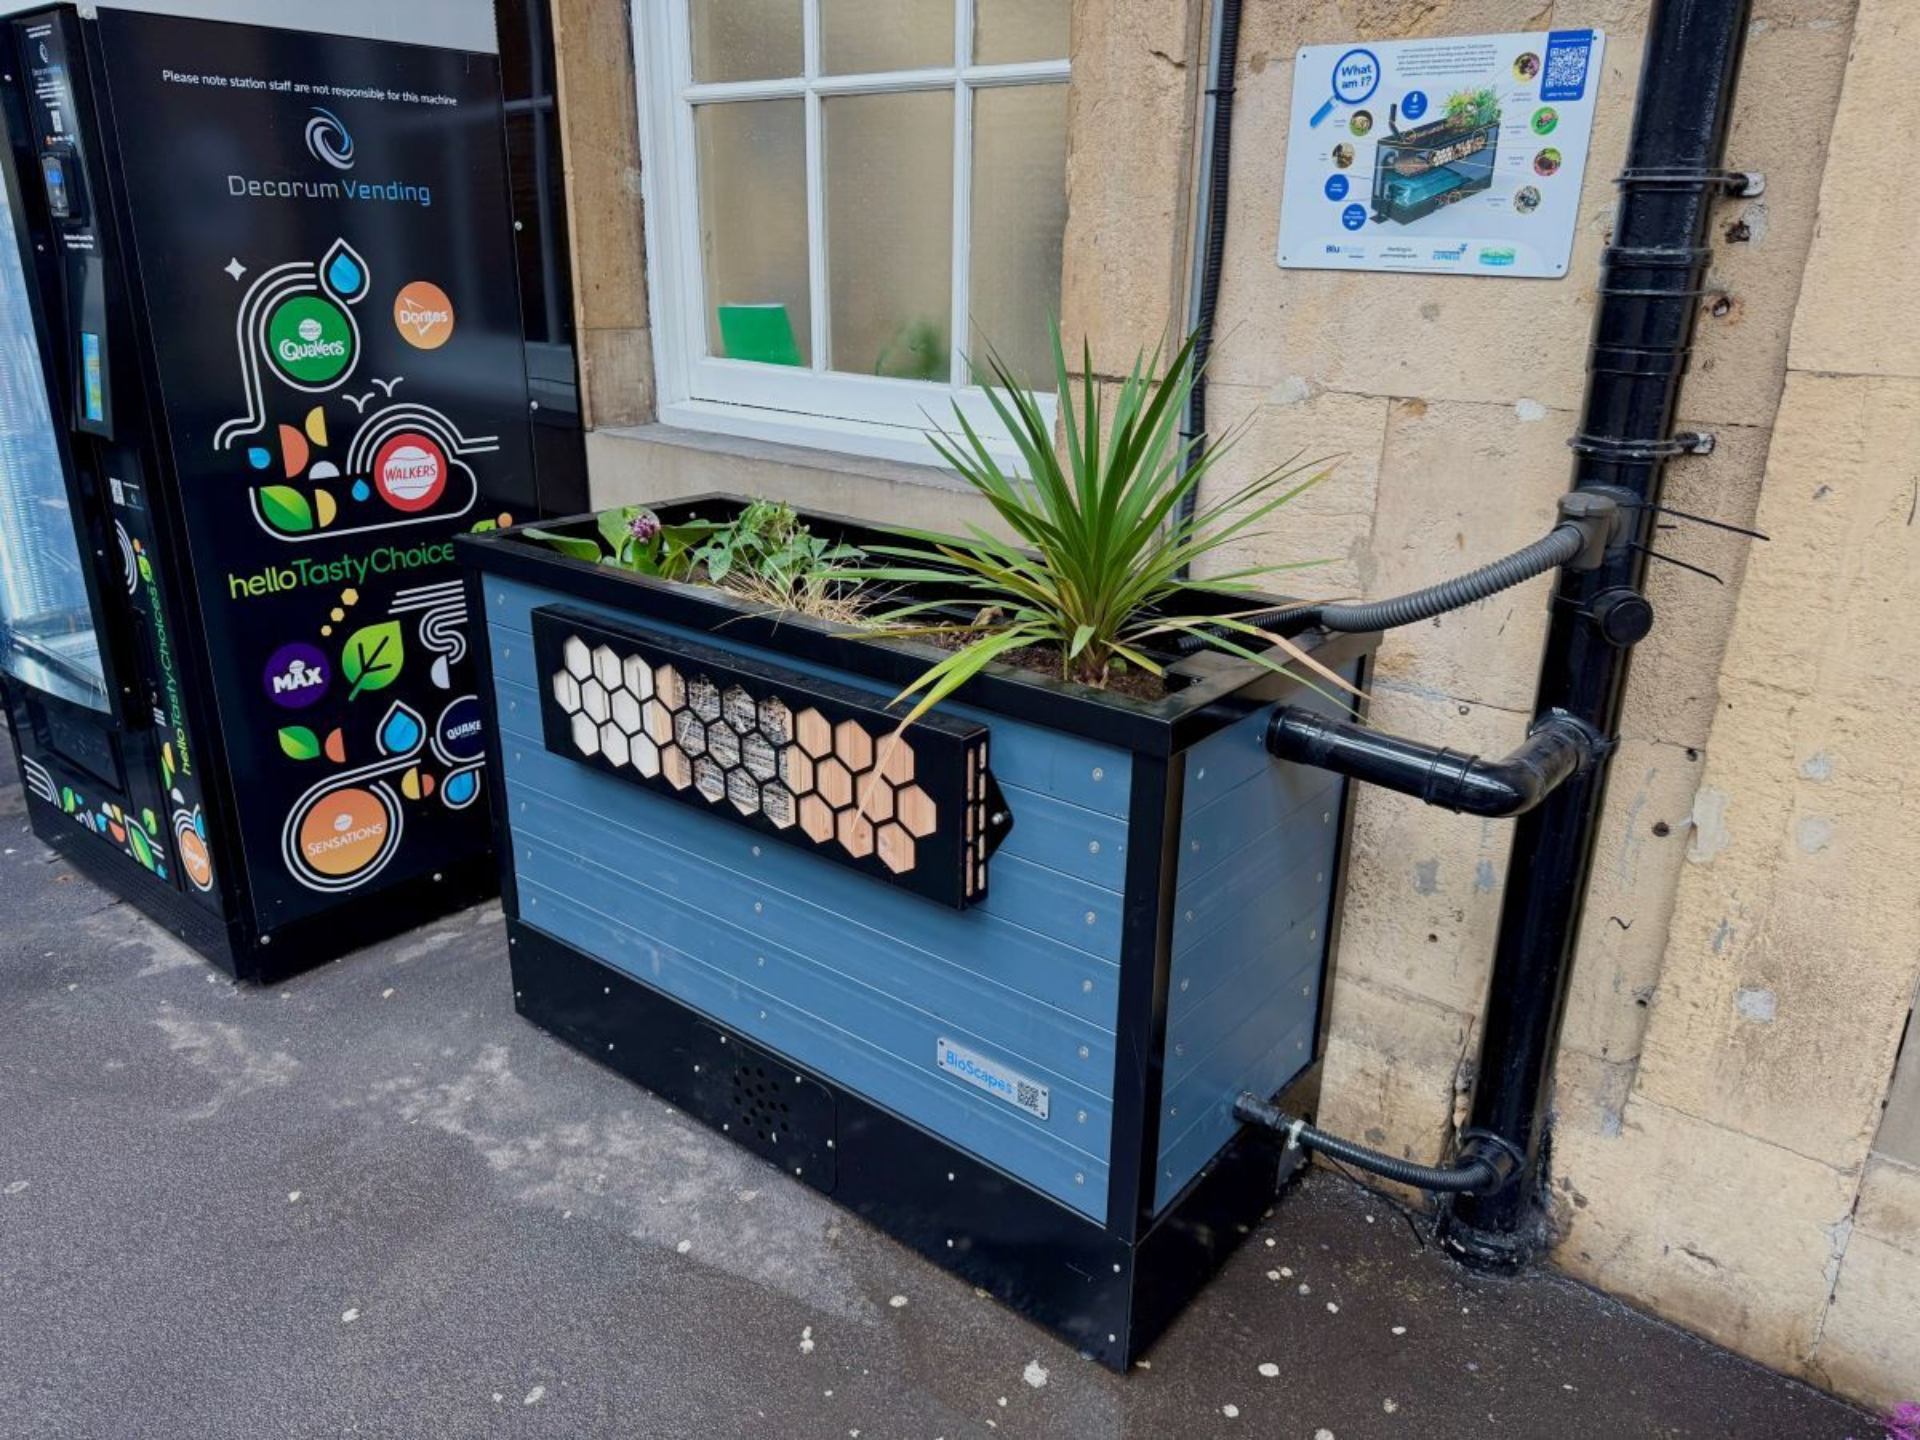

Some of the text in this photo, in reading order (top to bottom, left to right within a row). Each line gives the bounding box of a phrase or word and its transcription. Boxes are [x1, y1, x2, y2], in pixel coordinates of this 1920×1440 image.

[1341, 63, 1372, 77] What
[1342, 76, 1372, 89] am I?
[162, 70, 457, 106] Please note station staff are not responsible for this machine
[227, 175, 431, 206] Decorum Vending
[400, 309, 448, 324] Doritos
[279, 339, 345, 362] Quavers
[385, 463, 436, 482] WALKERS
[228, 542, 455, 599] helloTastyChoice
[273, 666, 323, 694] MAX
[446, 720, 482, 740] QUAKE
[307, 823, 383, 857] SENSATIONS
[946, 1050, 1013, 1095] BioScapes
